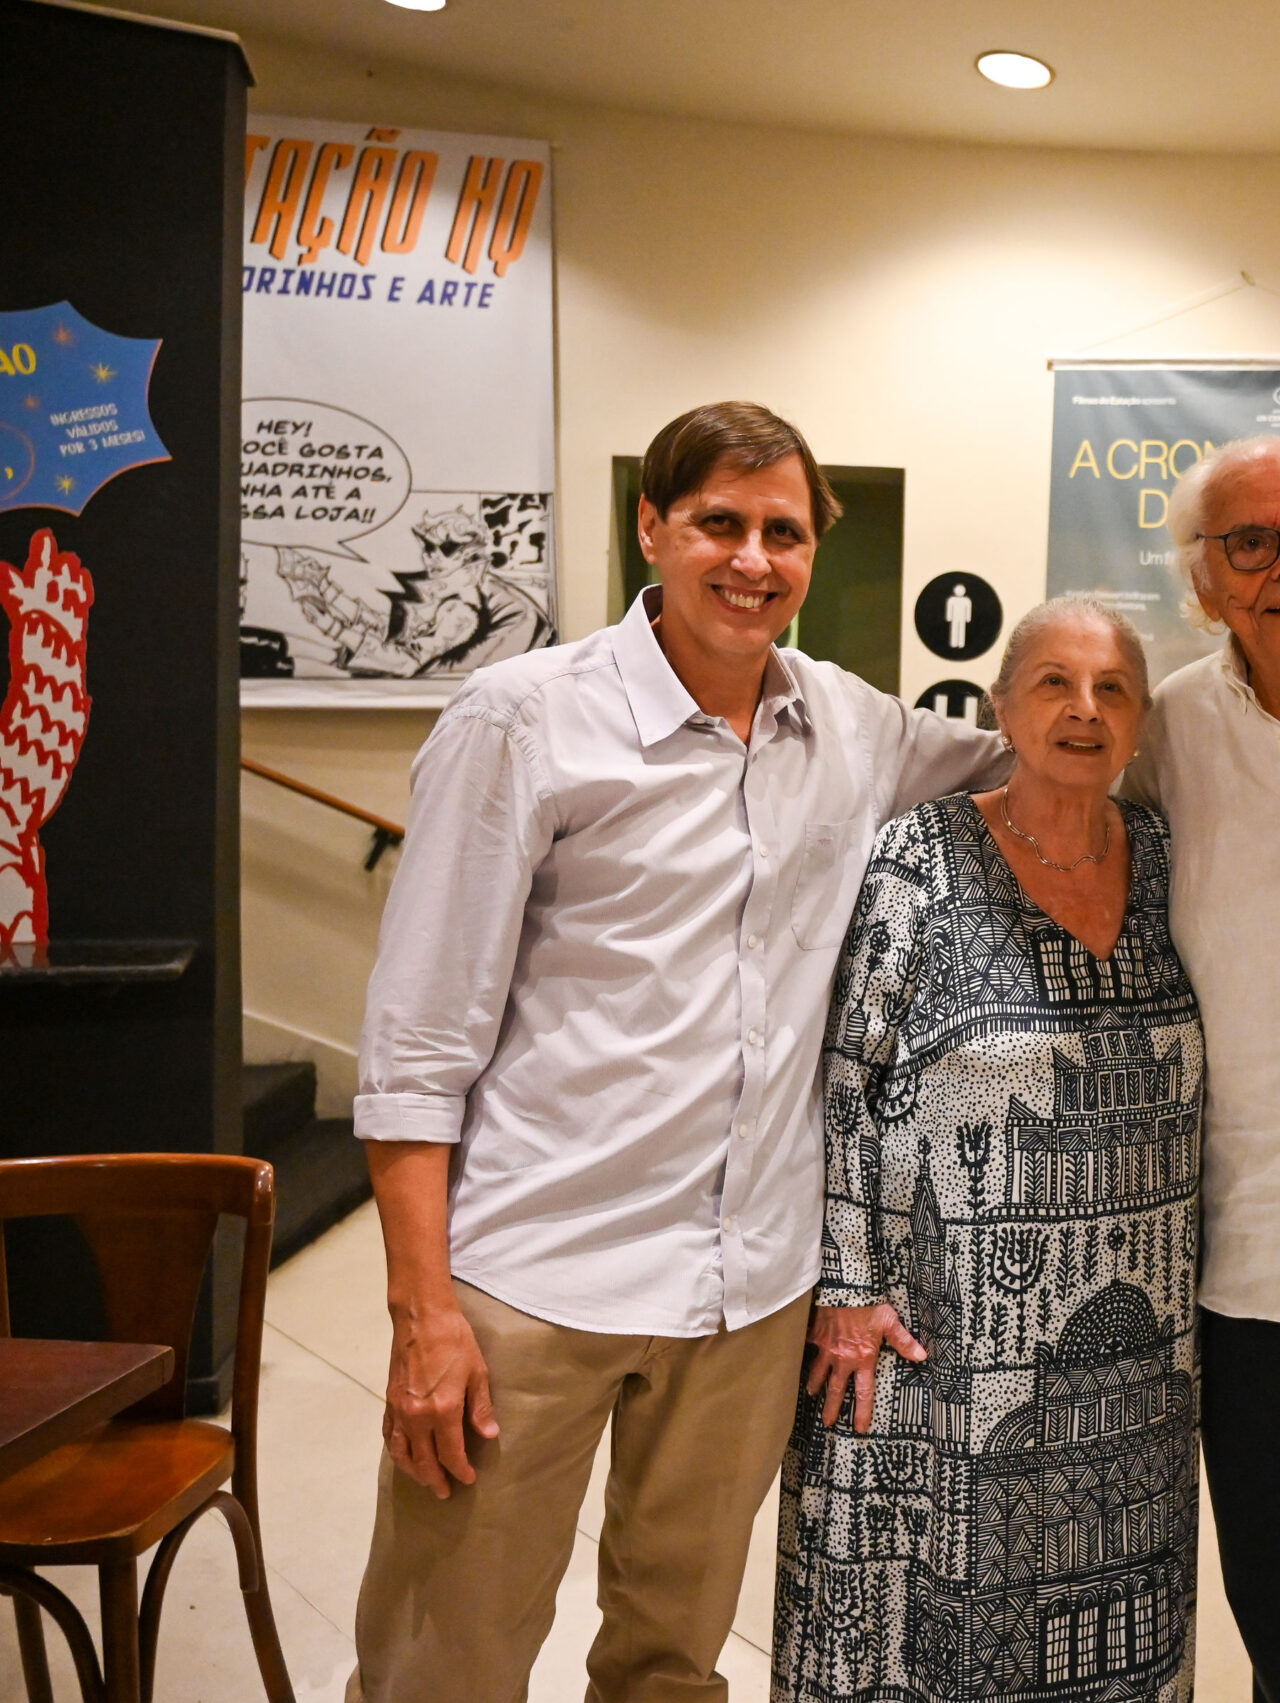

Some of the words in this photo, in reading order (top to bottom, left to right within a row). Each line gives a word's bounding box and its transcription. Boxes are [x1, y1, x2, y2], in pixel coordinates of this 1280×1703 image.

[445, 155, 544, 278] HQ
[387, 277, 405, 302] E
[416, 279, 495, 308] ARTE
[256, 419, 313, 438] HEY!
[59, 441, 85, 457] POR
[88, 438, 98, 451] 3
[299, 443, 383, 460] GOSTA
[1069, 439, 1100, 479] A
[346, 487, 361, 501] A
[295, 505, 376, 524] LOJA!!
[1138, 488, 1169, 529] D
